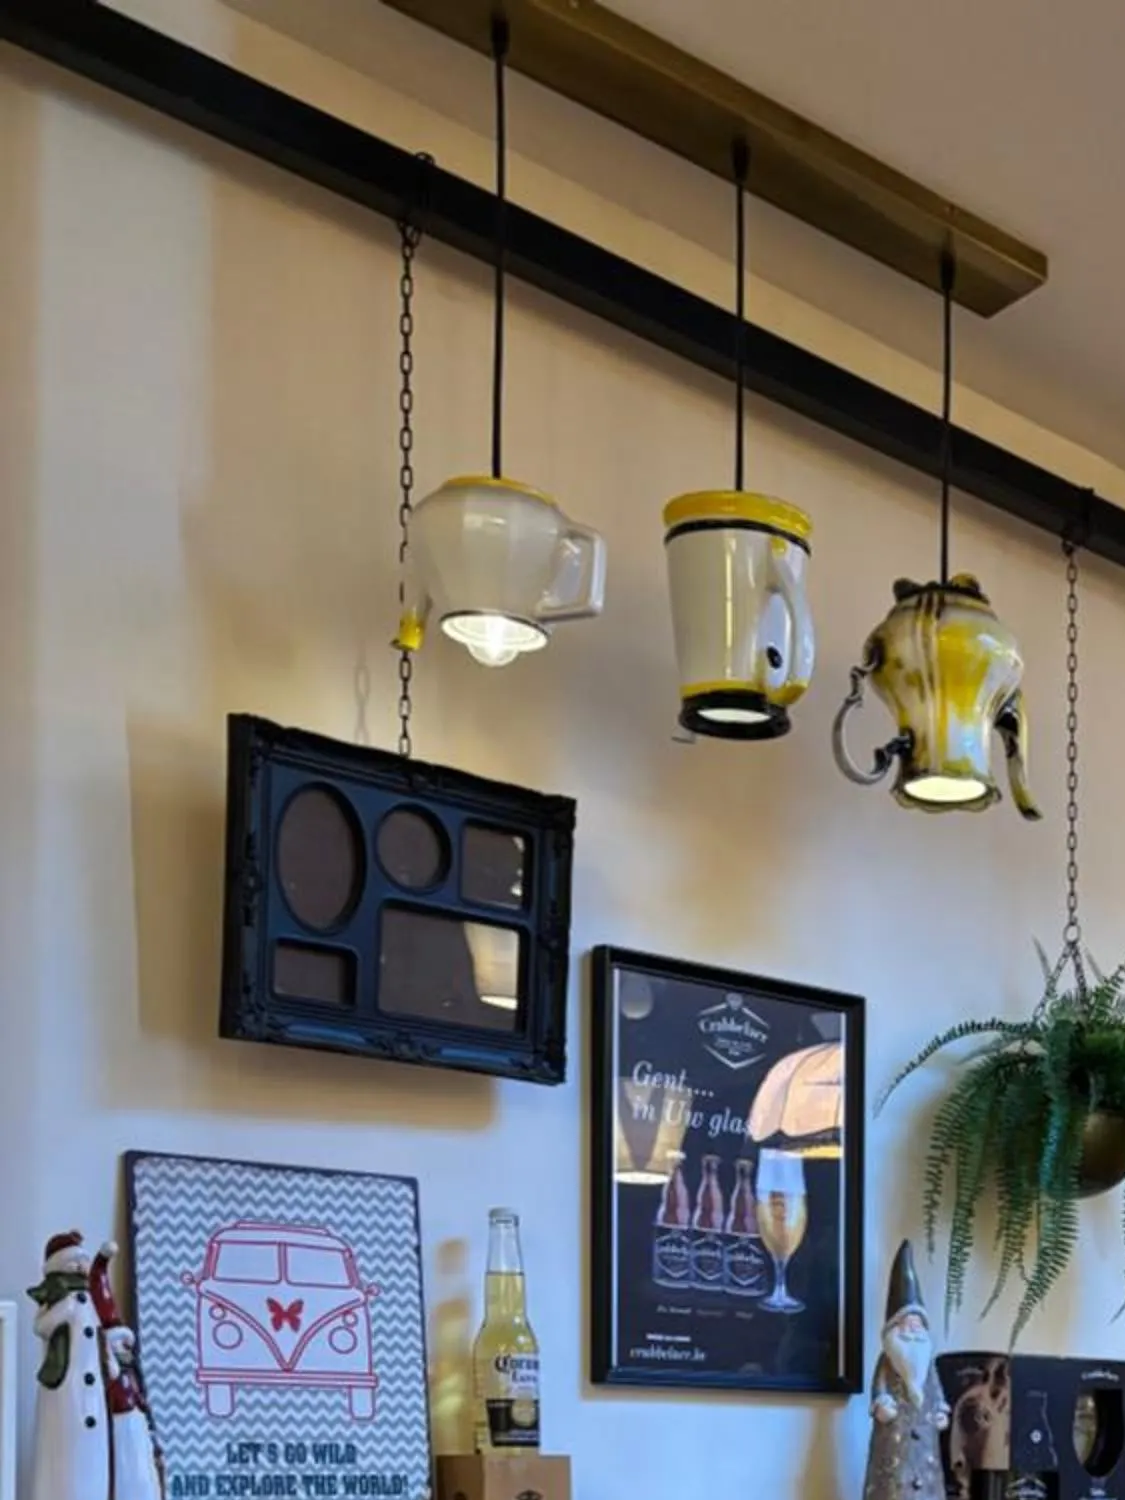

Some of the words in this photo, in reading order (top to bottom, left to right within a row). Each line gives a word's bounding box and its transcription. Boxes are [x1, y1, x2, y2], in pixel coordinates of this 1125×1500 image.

[632, 1095, 657, 1123] in
[226, 1442, 278, 1464] LET'S
[283, 1442, 307, 1464] GO
[312, 1442, 357, 1465] WILD
[171, 1474, 210, 1496] AND
[215, 1474, 298, 1496] EXPLORE
[301, 1474, 337, 1496] THE
[342, 1474, 409, 1496] WORLD!
